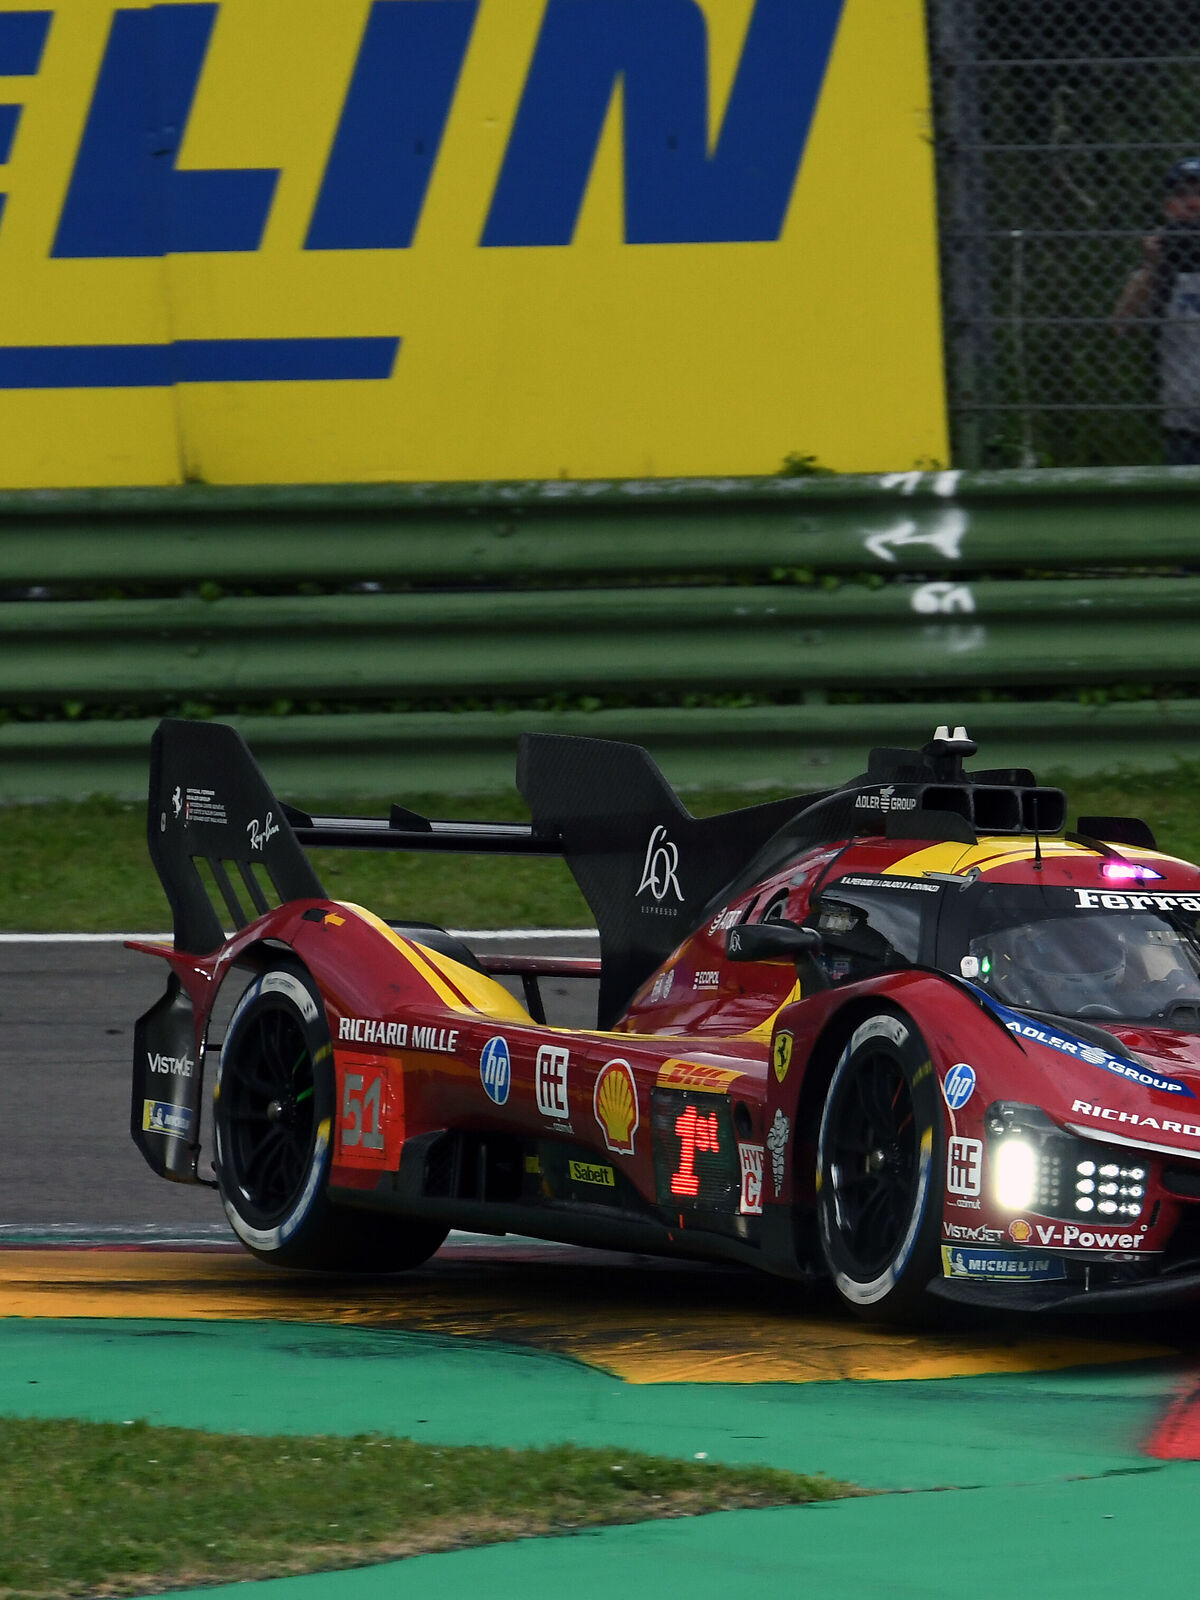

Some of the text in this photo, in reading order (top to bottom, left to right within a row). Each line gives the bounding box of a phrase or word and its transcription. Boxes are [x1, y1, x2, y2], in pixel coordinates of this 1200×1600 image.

[0, 0, 845, 259] LIN
[855, 795, 917, 810] ADLER GROUP
[338, 1017, 459, 1053] RICHARD MILLE
[1005, 1021, 1182, 1092] ADLER GROUP
[484, 1053, 506, 1097] hp
[667, 1063, 730, 1087] DHL
[946, 1068, 975, 1105] hp
[341, 1073, 385, 1150] 51
[573, 1162, 610, 1184] Sabelt
[1036, 1225, 1144, 1249] V-Power
[967, 1258, 1050, 1273] MICHELIN
